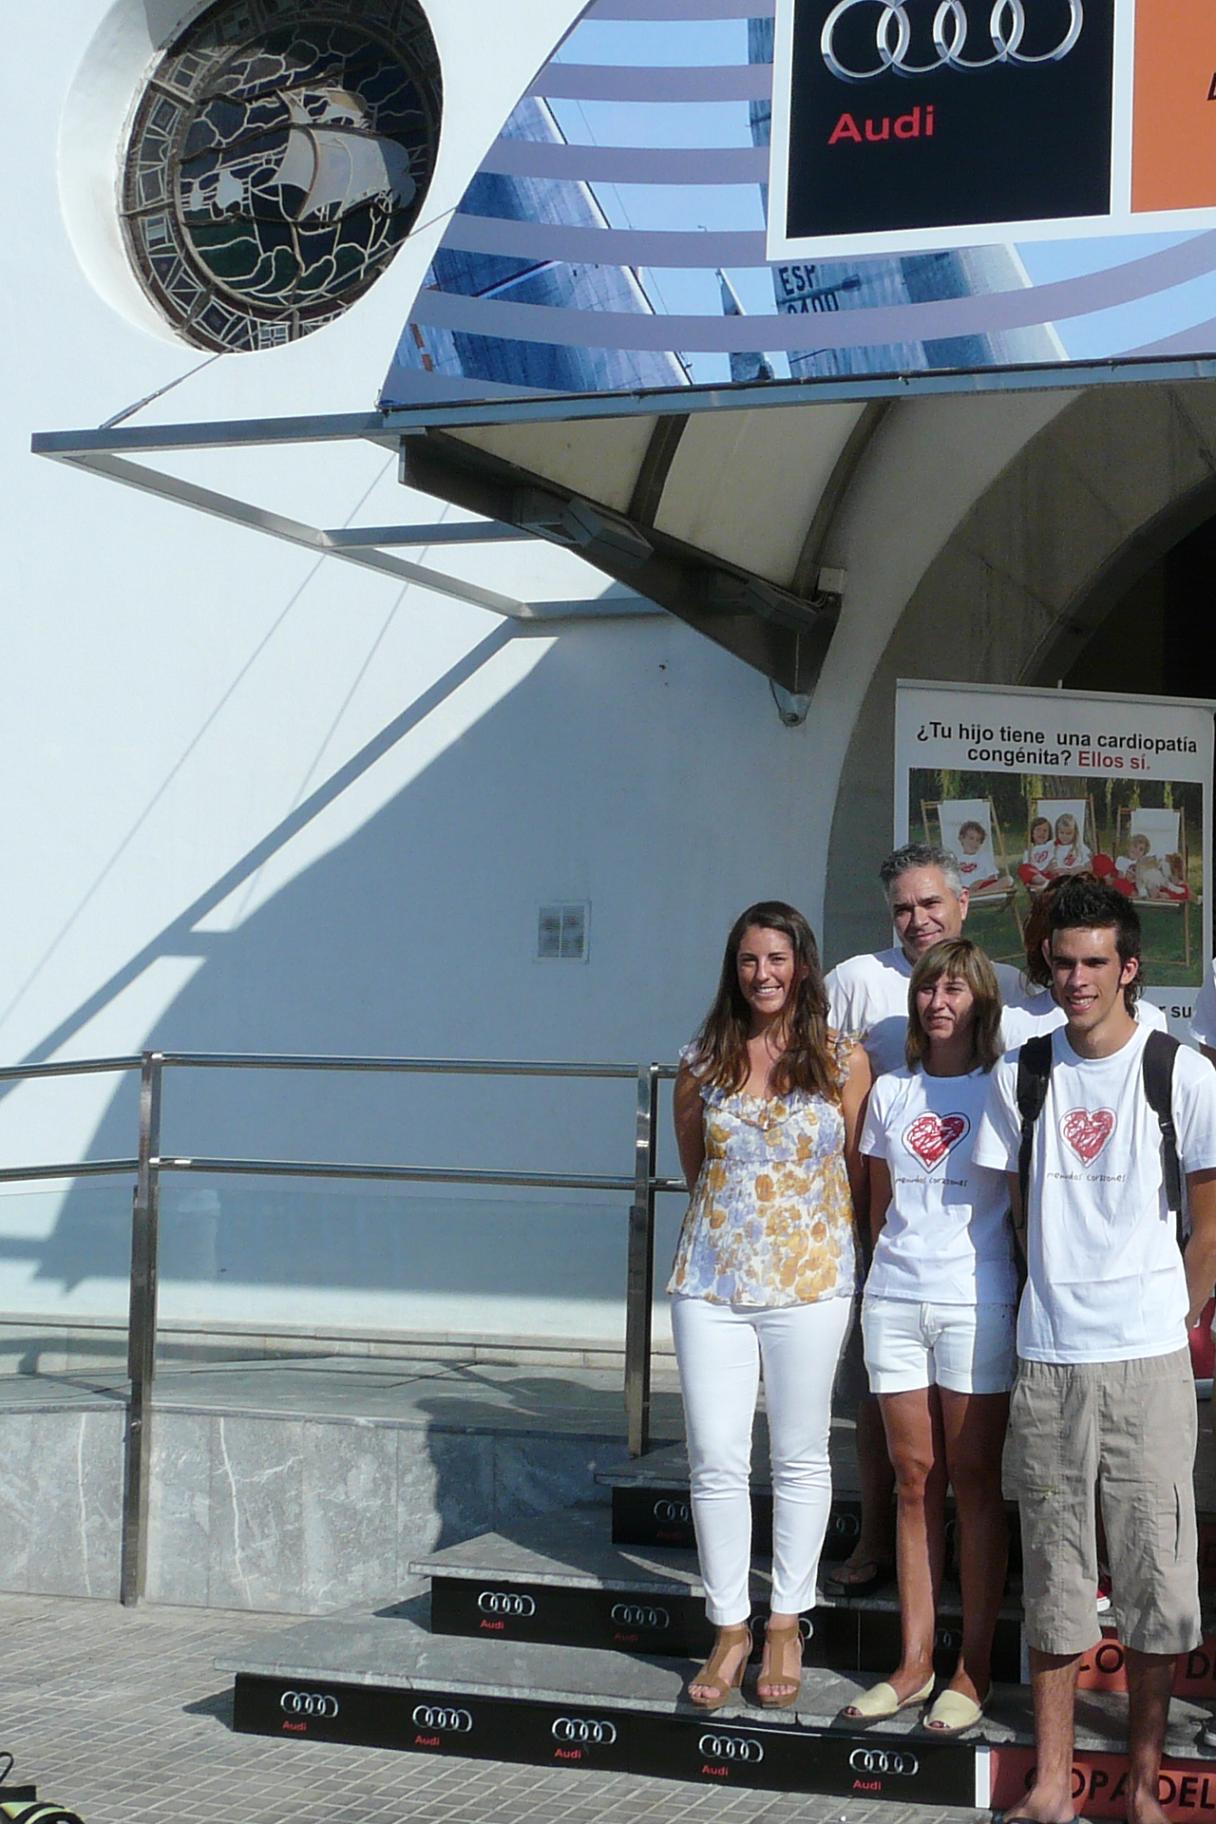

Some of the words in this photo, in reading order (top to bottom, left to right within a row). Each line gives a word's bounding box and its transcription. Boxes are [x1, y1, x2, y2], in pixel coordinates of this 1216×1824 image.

[828, 105, 934, 144] Audi
[917, 721, 951, 741] ¿Tu
[959, 723, 994, 744] hijo
[1000, 726, 1045, 744] tiene
[1057, 733, 1091, 746] una
[1097, 733, 1197, 754] cardiopatía
[967, 747, 1072, 766] congénita?
[1078, 751, 1124, 768] Ellos
[1130, 754, 1151, 770] sí.
[1171, 1006, 1192, 1018] su
[480, 1618, 504, 1630] Audi
[614, 1631, 639, 1642] Audi
[282, 1720, 307, 1732] Audi
[415, 1734, 440, 1746] Audi
[554, 1748, 582, 1760] Audi
[702, 1765, 729, 1777] Audi
[853, 1779, 883, 1791] Audi
